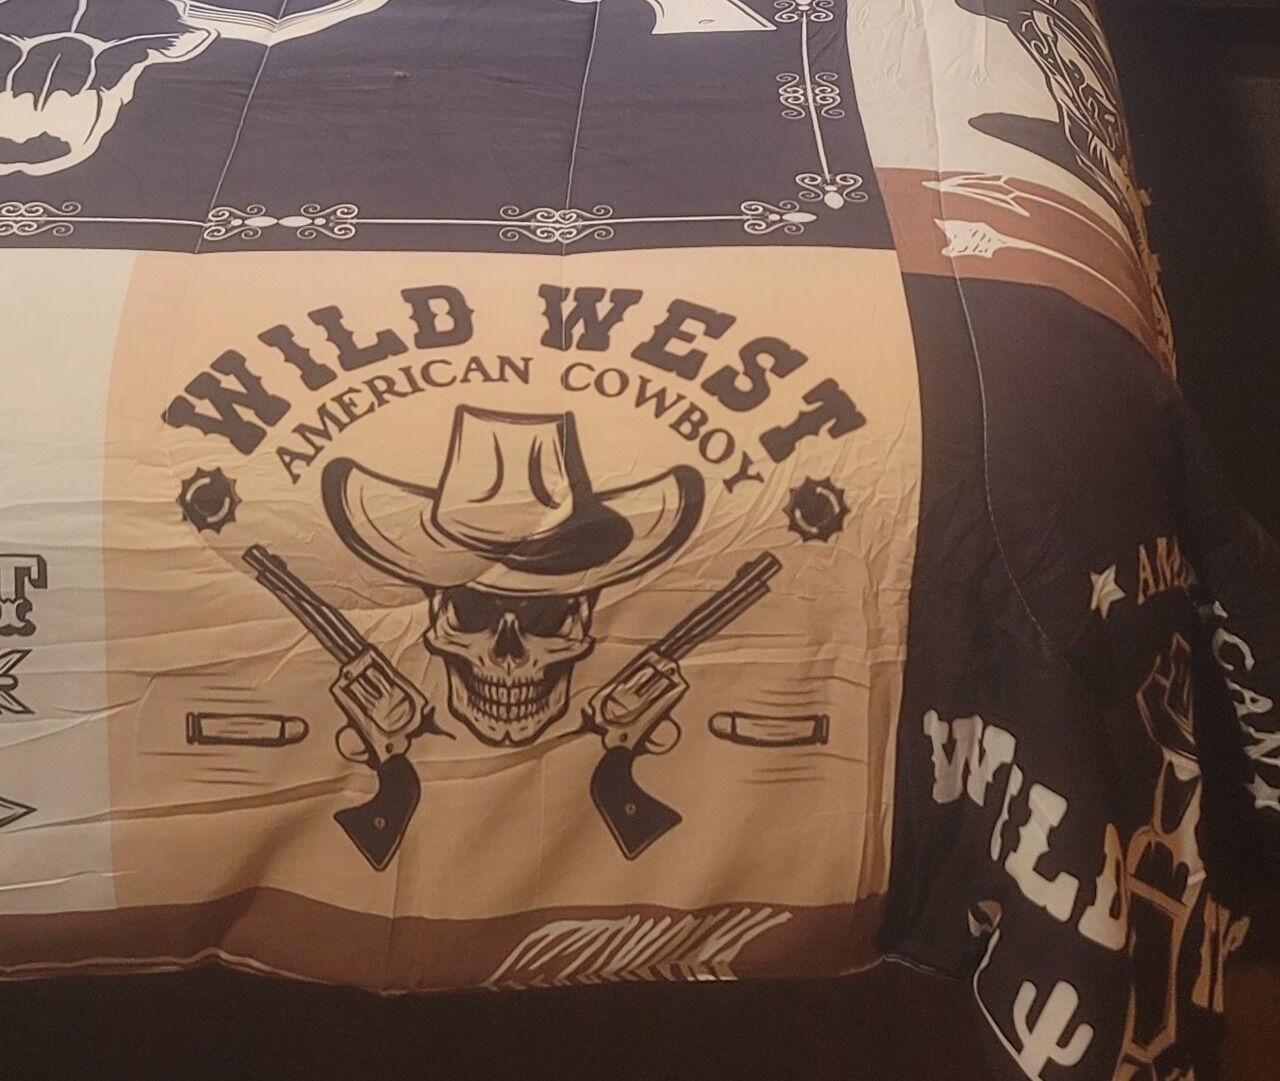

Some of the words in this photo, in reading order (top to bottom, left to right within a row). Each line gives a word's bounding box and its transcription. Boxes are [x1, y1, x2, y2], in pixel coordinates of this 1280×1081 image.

[161, 284, 475, 455] WILD
[537, 283, 867, 463] WEST
[272, 354, 531, 485] AMERICAN
[561, 361, 763, 494] COWBOY
